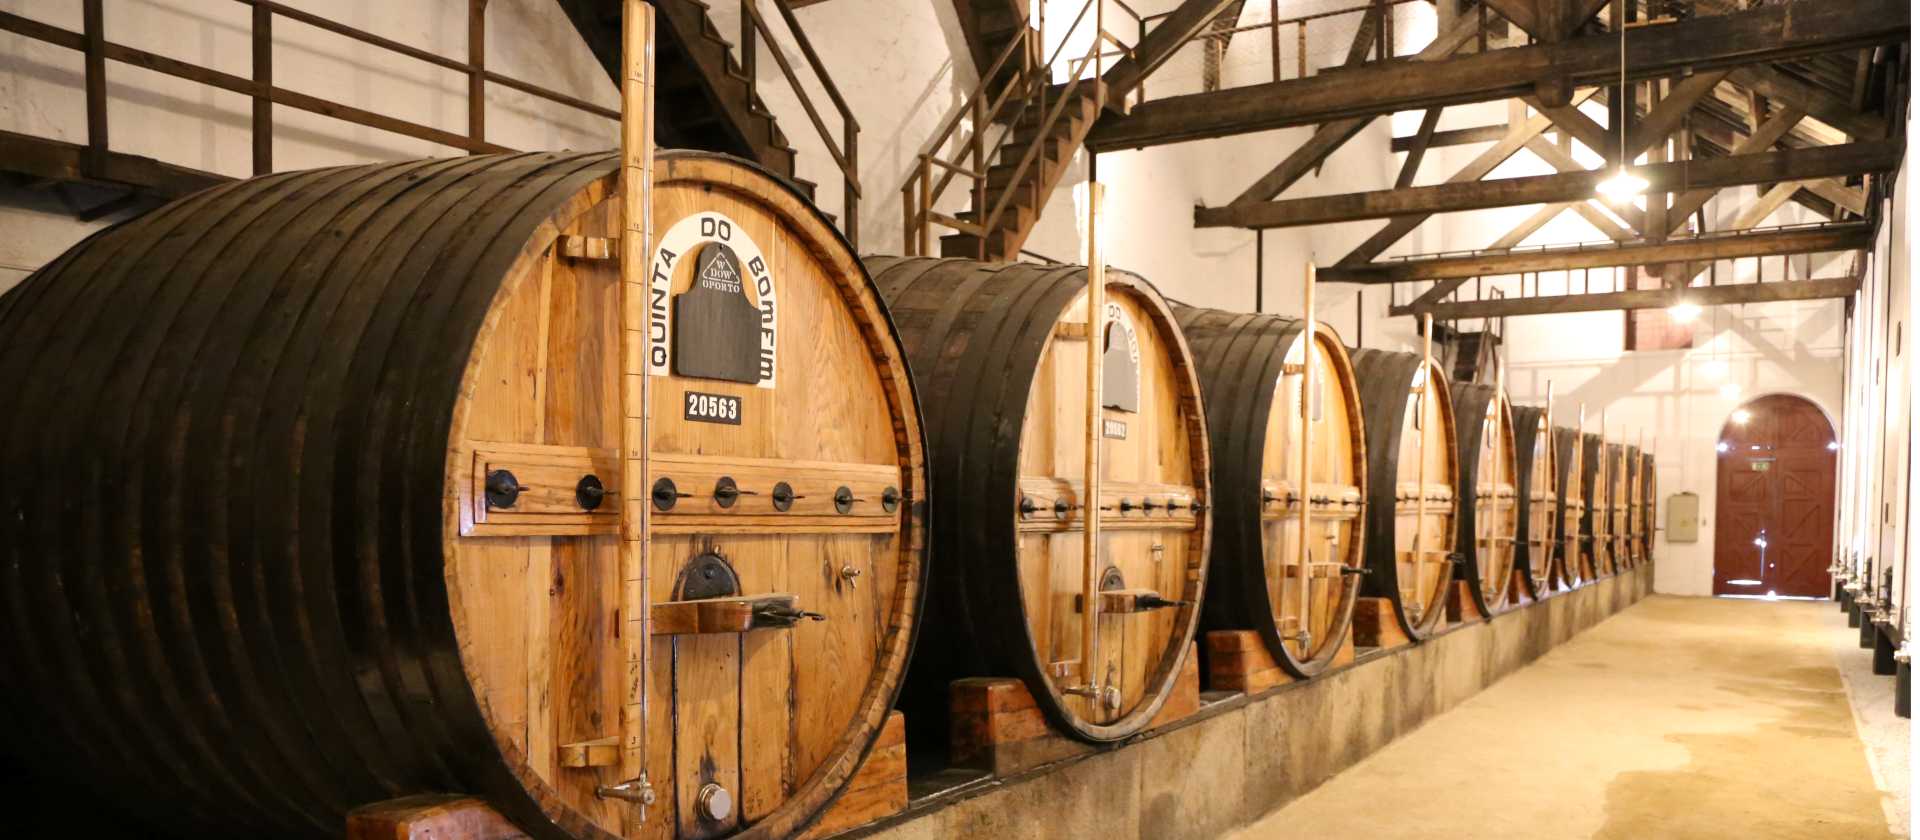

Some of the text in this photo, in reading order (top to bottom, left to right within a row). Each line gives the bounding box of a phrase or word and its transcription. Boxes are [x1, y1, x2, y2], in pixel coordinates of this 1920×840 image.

[710, 268, 732, 280] DOW
[651, 247, 677, 367] QUINTA
[701, 217, 731, 241] DO
[702, 279, 740, 293] OPORTO
[688, 394, 737, 419] 20563
